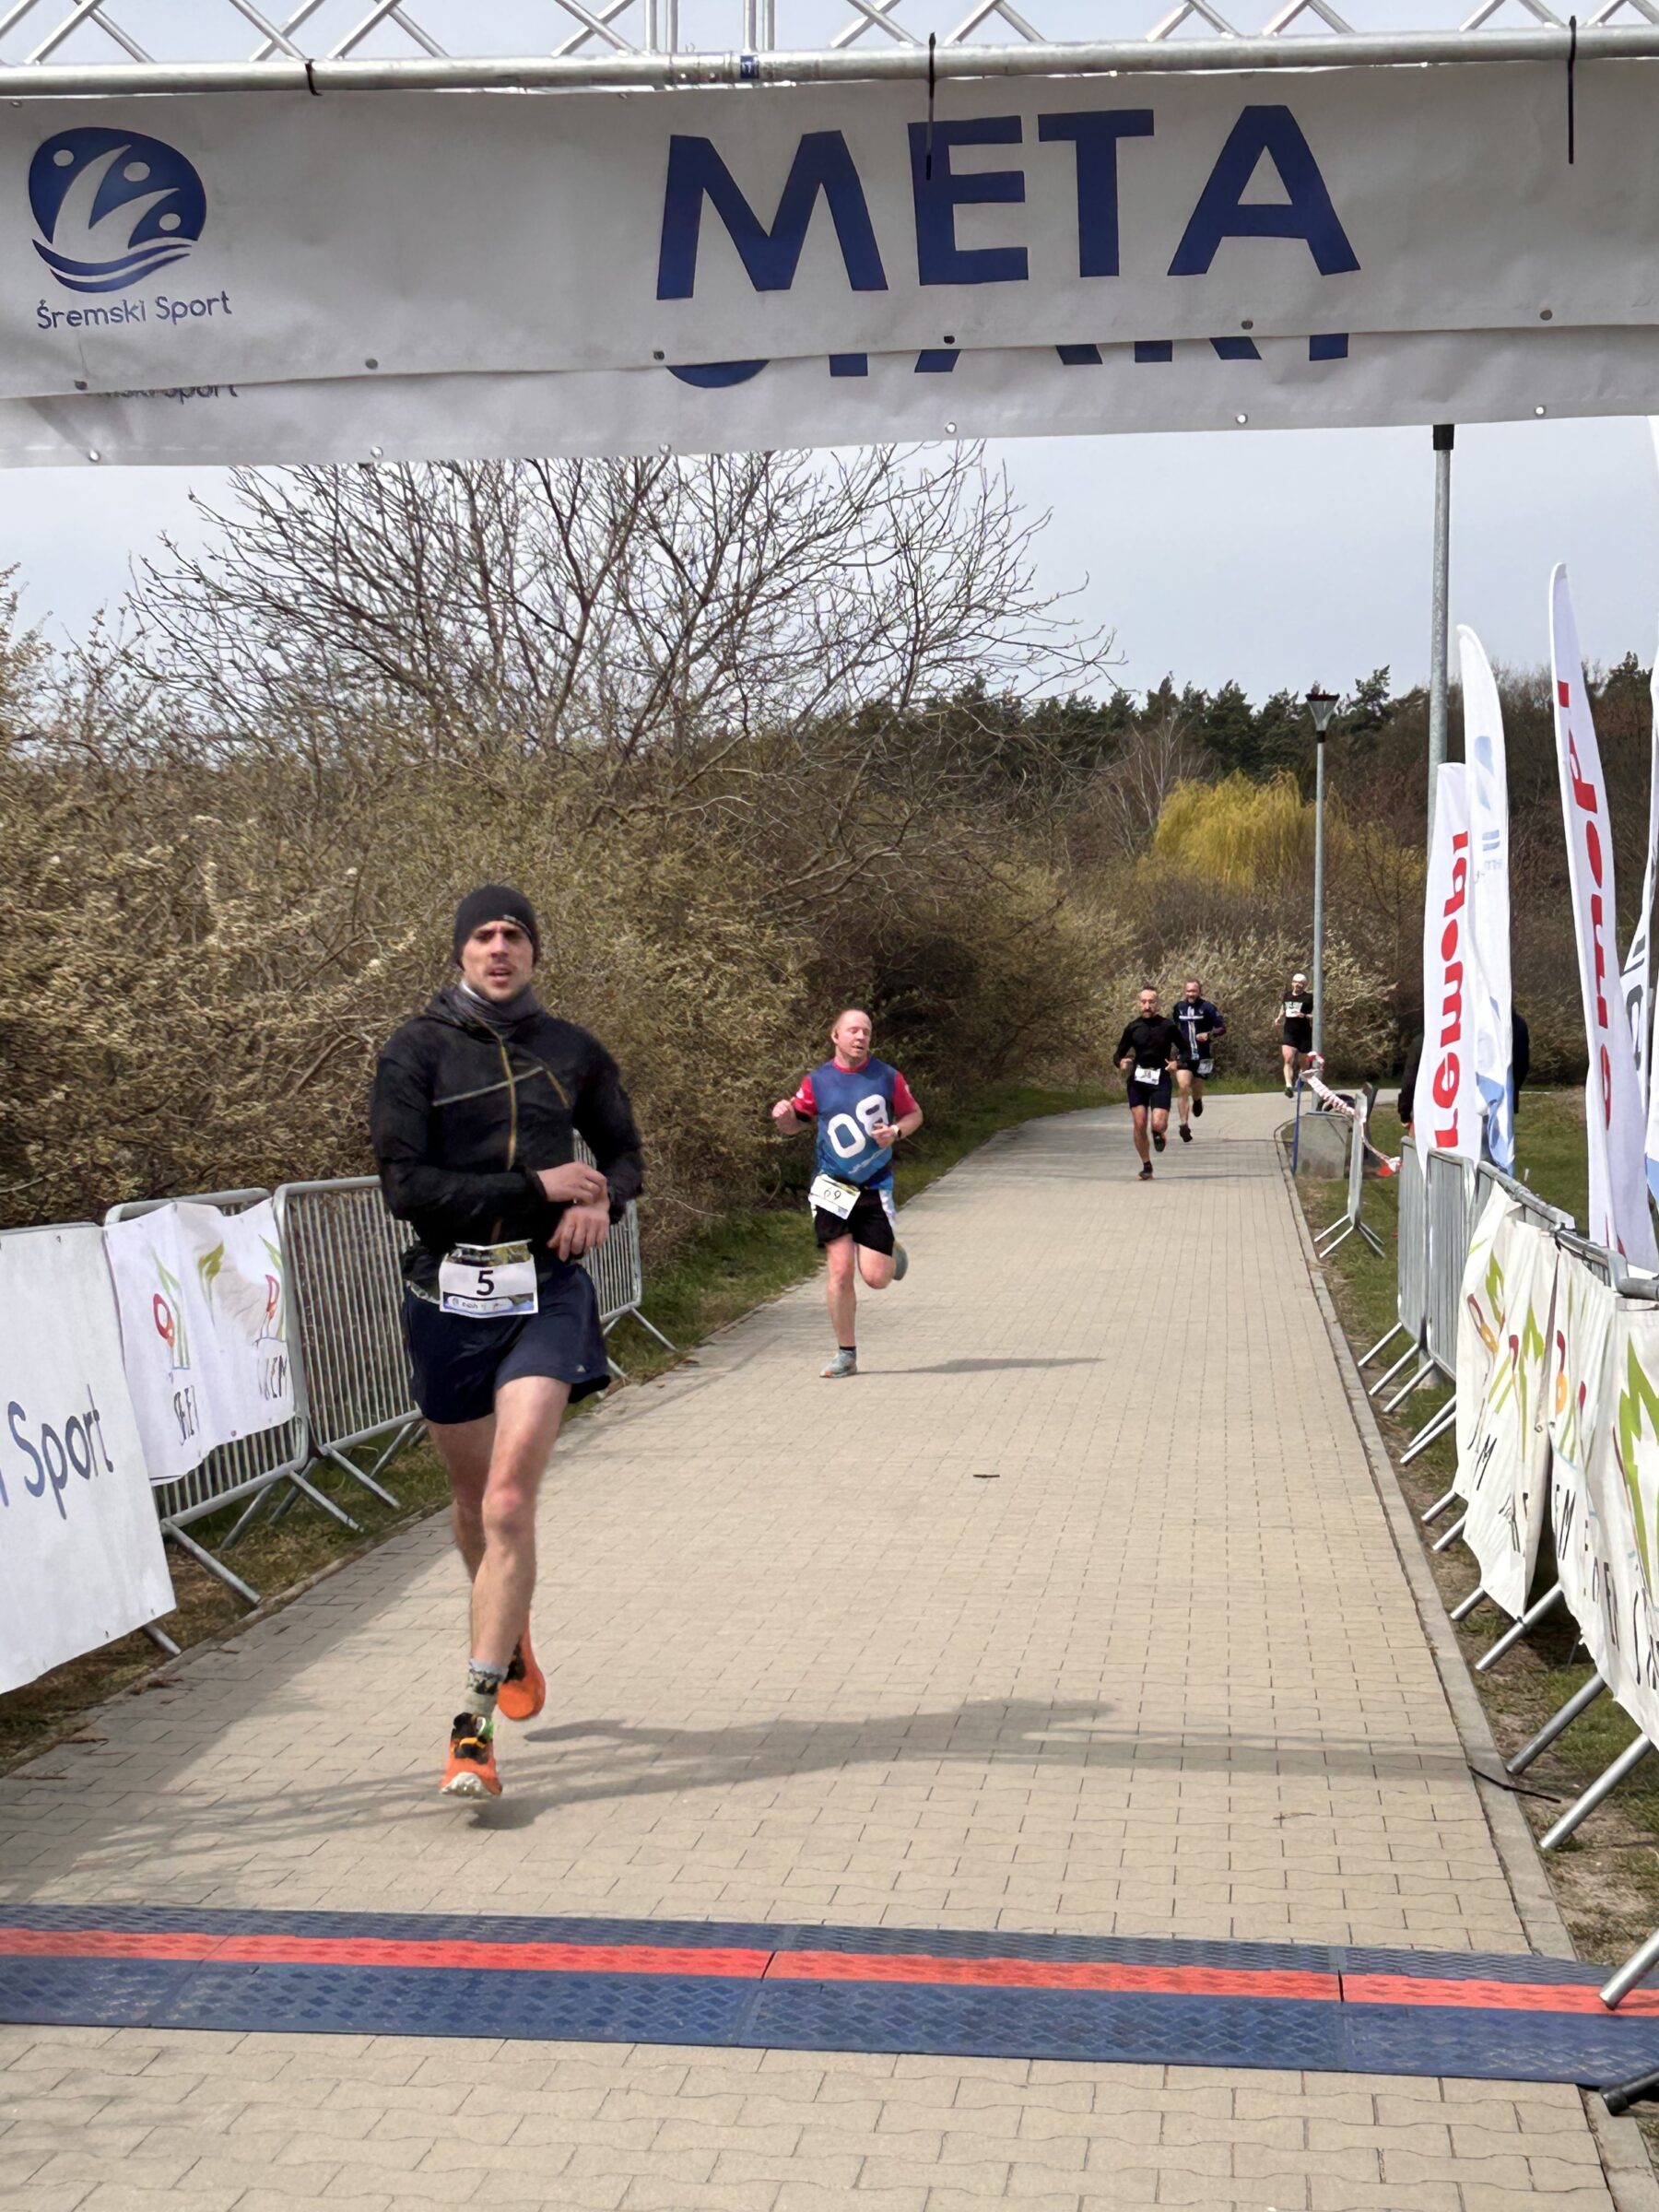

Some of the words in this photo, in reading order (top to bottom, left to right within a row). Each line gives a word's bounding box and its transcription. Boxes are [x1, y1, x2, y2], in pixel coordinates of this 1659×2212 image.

[657, 105, 1361, 300] META
[37, 300, 147, 329] Śremski
[156, 290, 232, 324] Sport
[477, 1270, 494, 1296] 5
[8, 1383, 113, 1519] Sport
